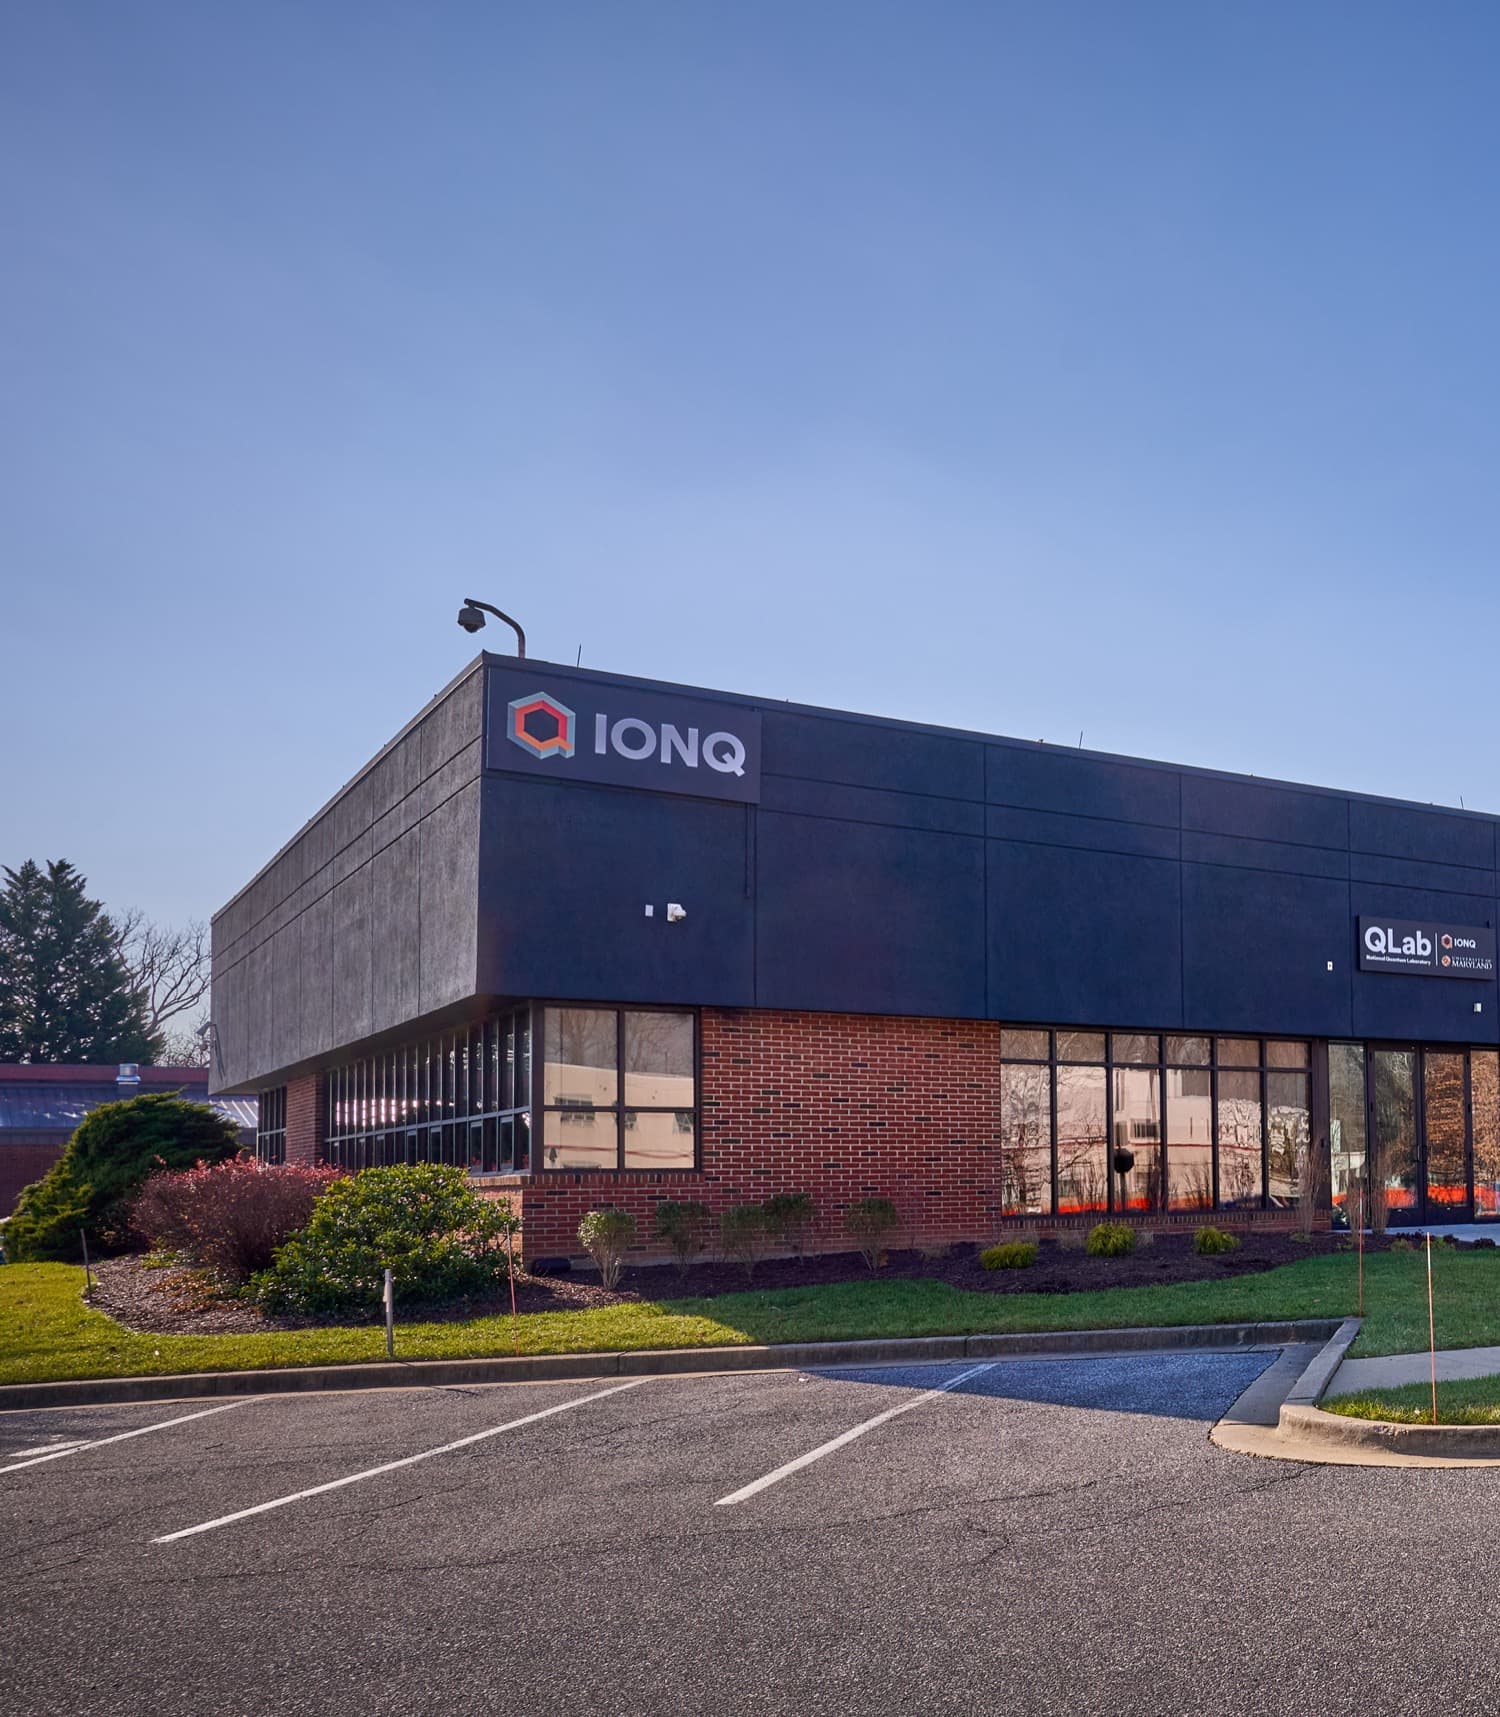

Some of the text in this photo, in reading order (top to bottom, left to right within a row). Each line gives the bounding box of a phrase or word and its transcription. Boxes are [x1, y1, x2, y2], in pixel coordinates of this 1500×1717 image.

[594, 713, 746, 777] IONQ
[1364, 926, 1432, 956] QLab
[1454, 938, 1476, 949] IONQ
